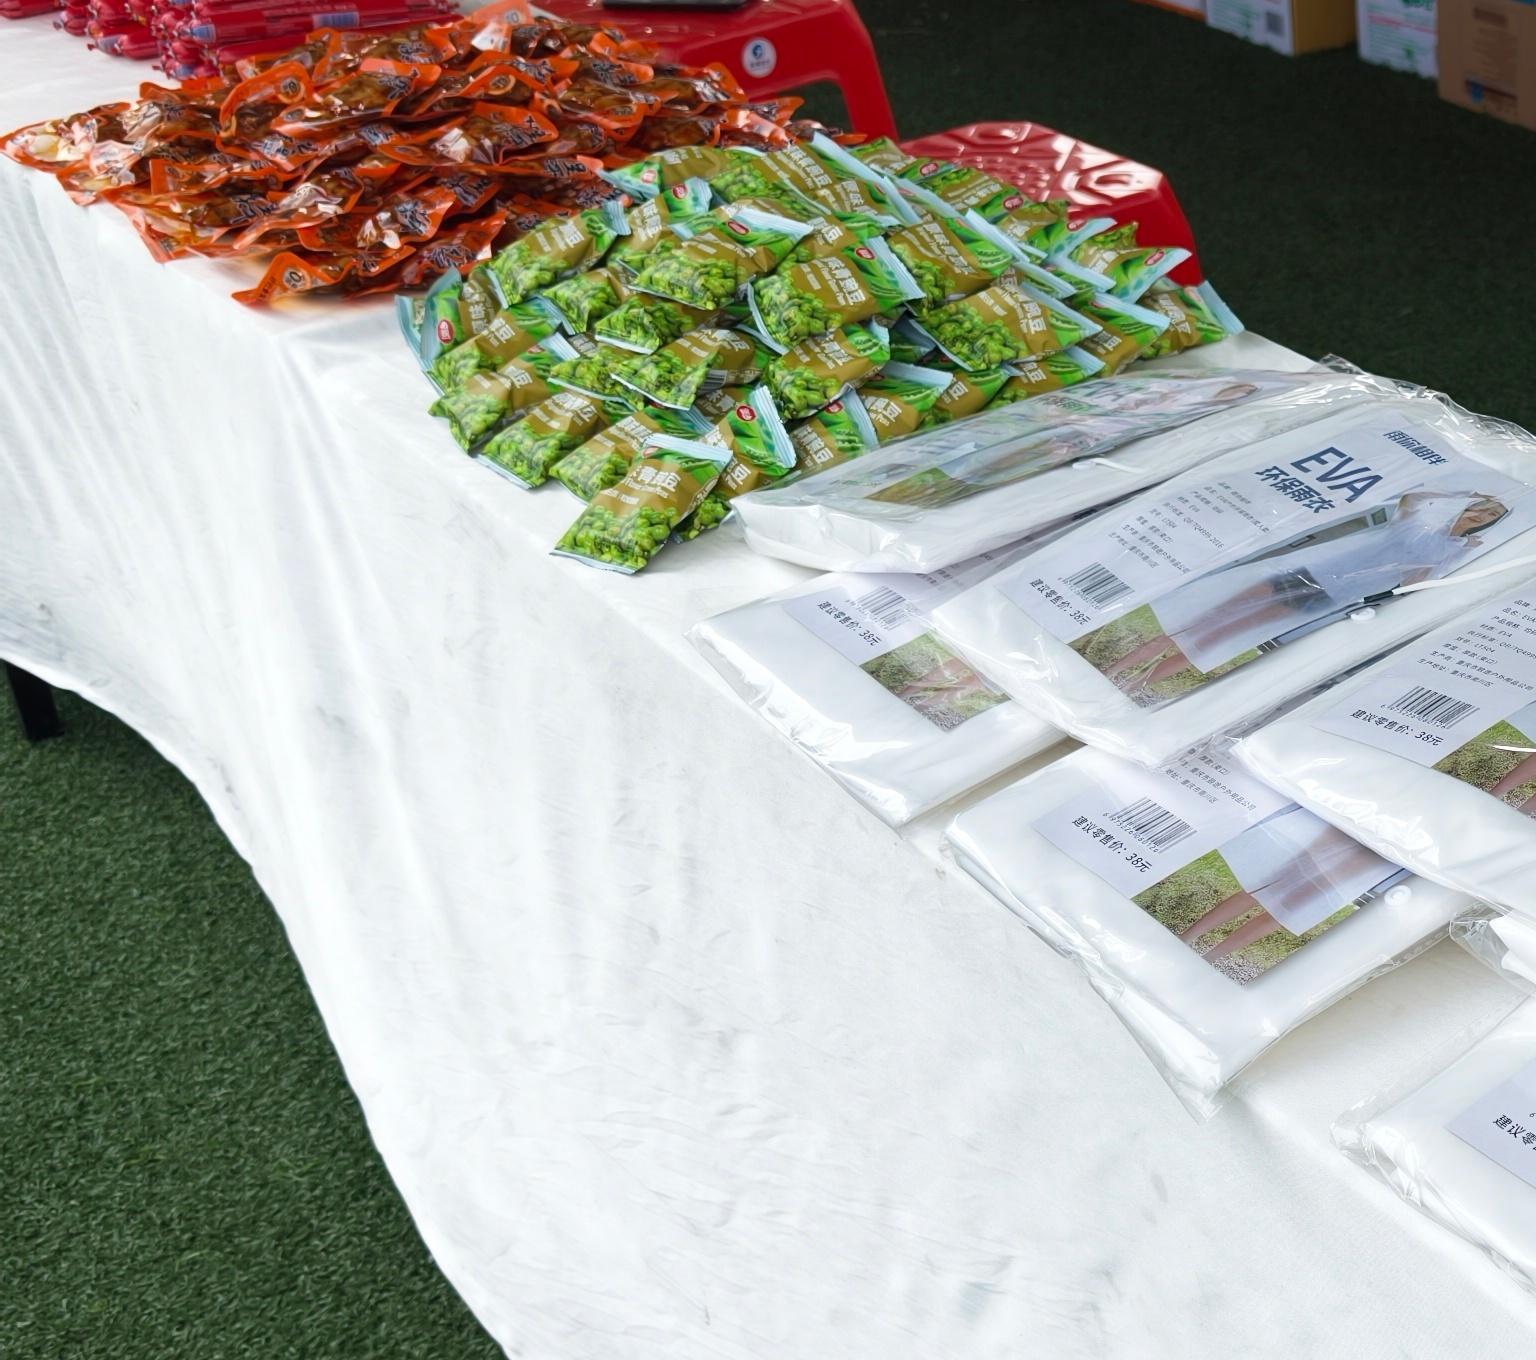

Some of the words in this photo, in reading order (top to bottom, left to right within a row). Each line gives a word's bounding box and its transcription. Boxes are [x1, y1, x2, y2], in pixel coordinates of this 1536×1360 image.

[1254, 464, 1337, 515] 环保雨衣
[1289, 446, 1385, 504] EVA
[1071, 815, 1153, 874] 建议零售价：38元
